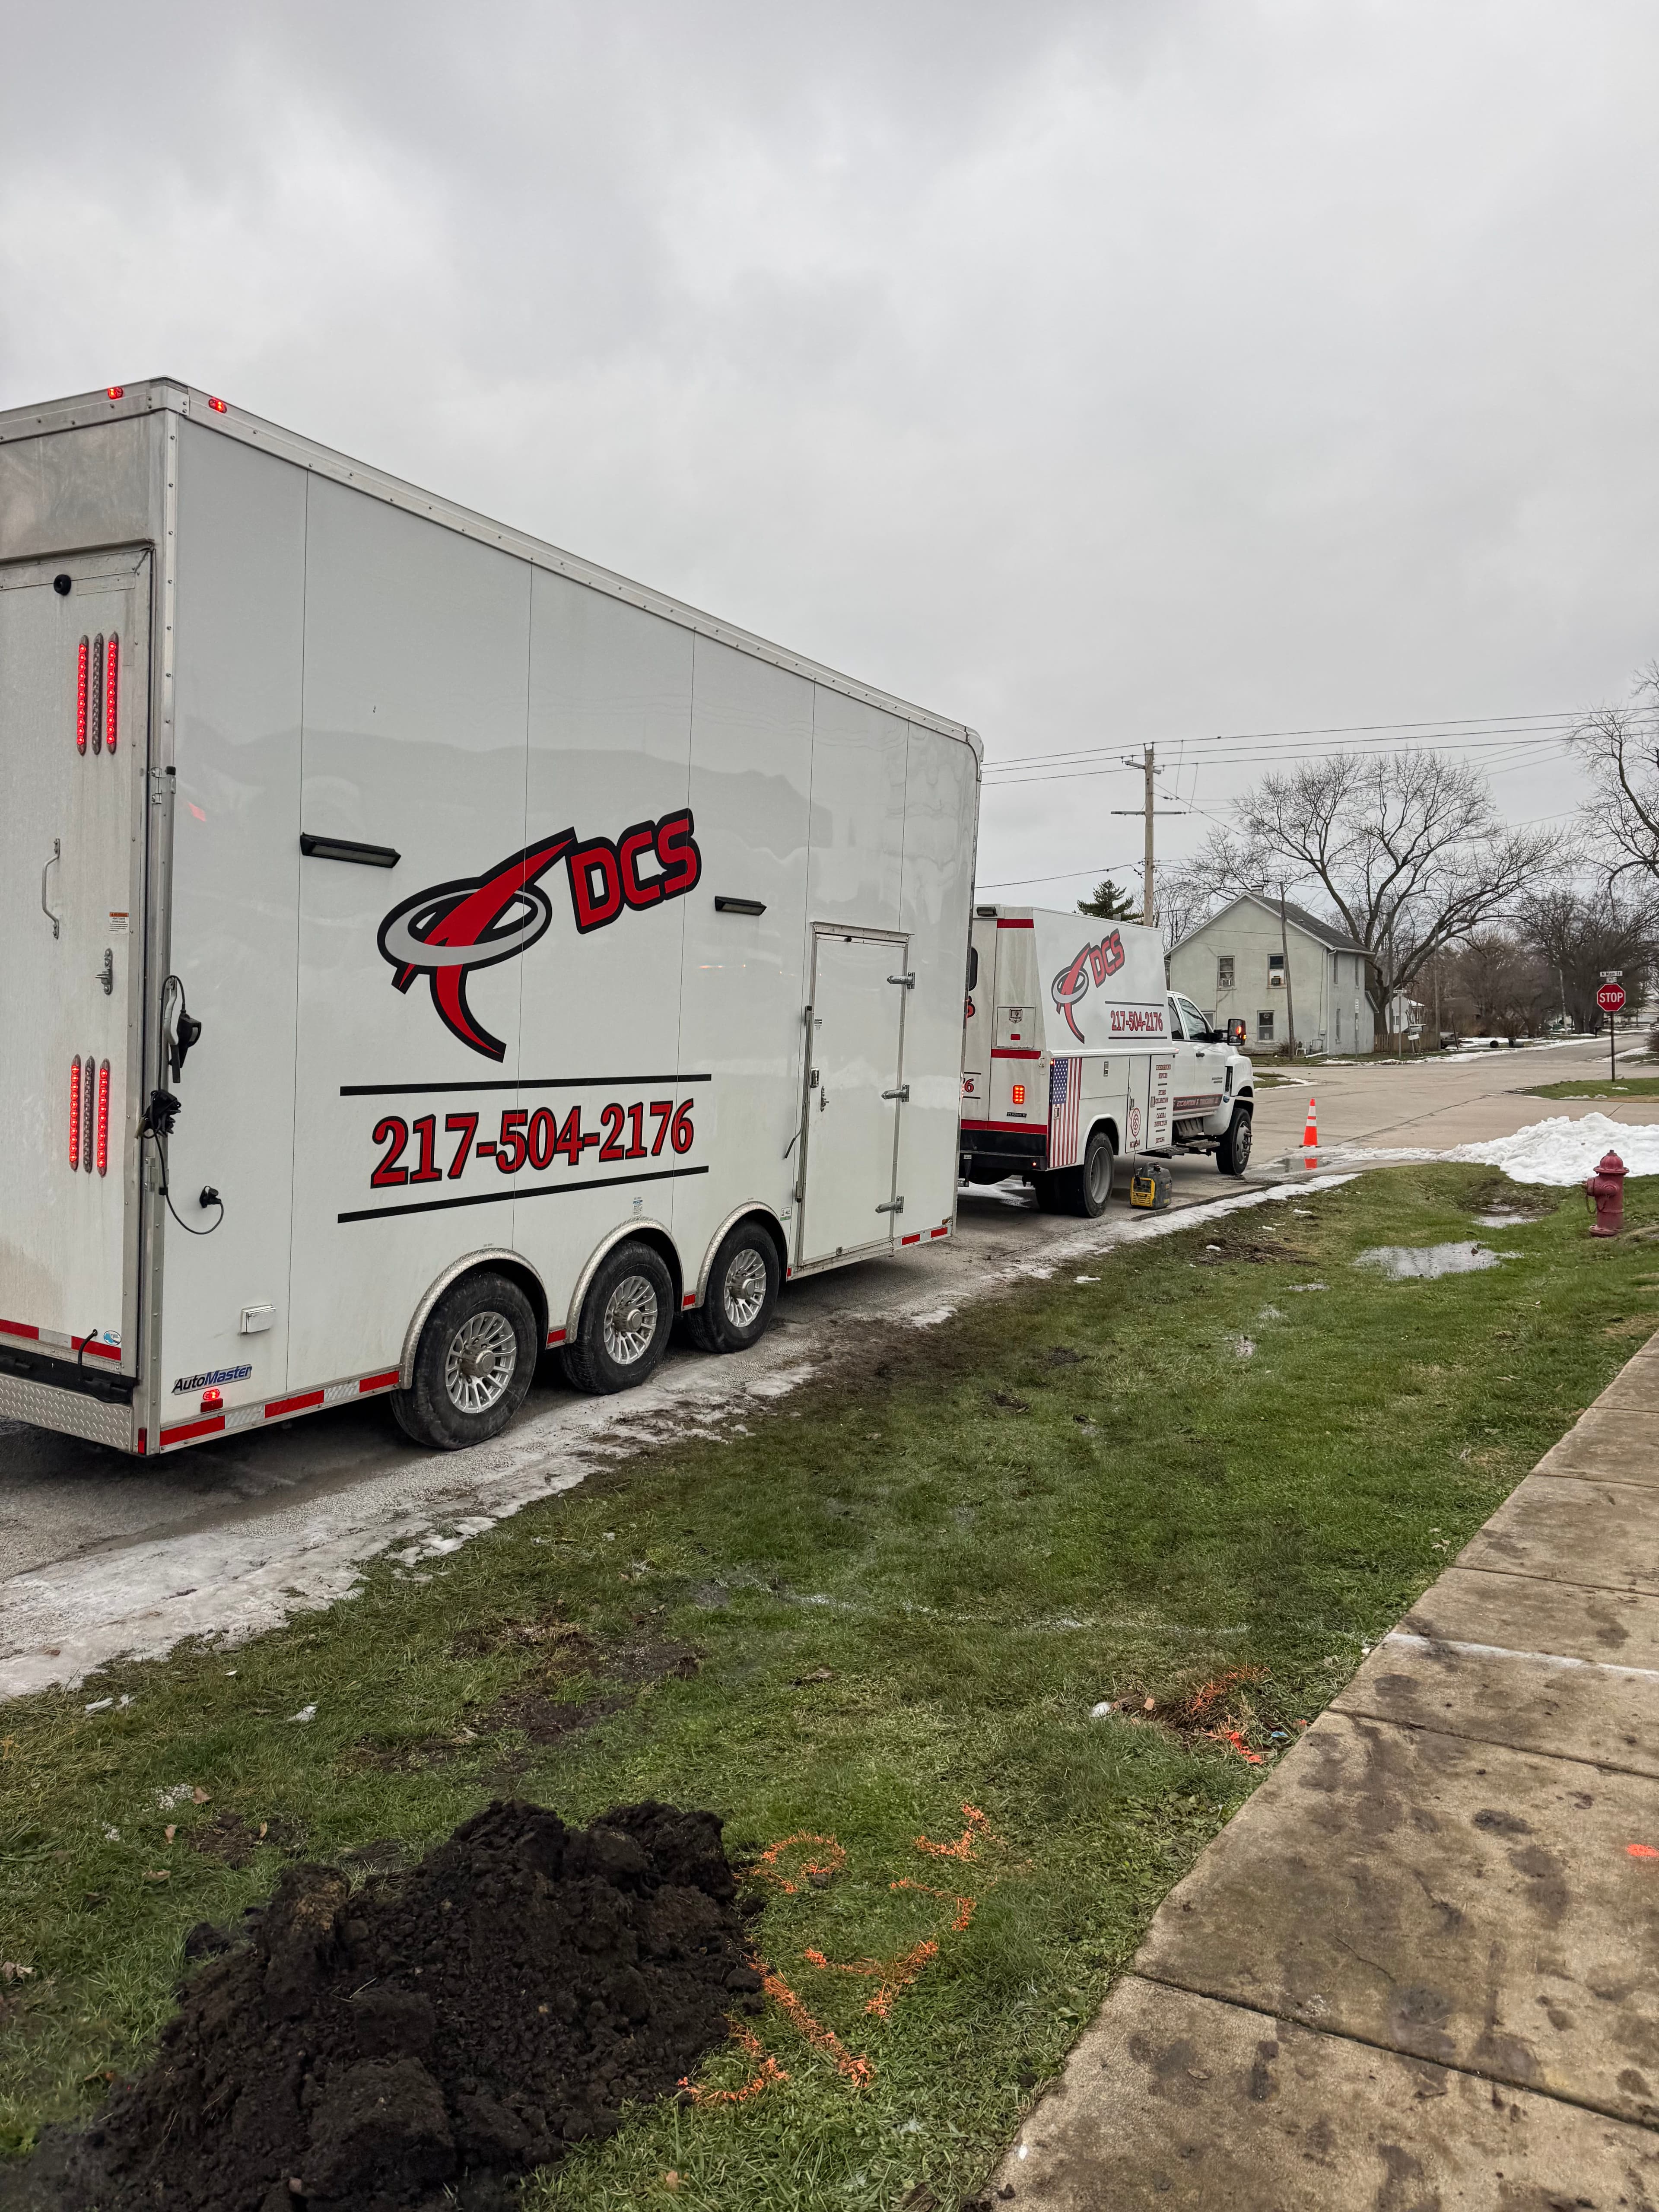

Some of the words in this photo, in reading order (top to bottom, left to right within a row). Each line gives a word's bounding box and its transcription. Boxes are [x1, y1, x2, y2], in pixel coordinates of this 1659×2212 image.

[565, 808, 702, 934] DCS
[1089, 928, 1125, 988] DCS
[1599, 992, 1623, 1003] STOP
[1110, 1010, 1163, 1032] 217-504-2176
[370, 1097, 694, 1189] 217-504-2176
[171, 1365, 252, 1394] AutoMaster
